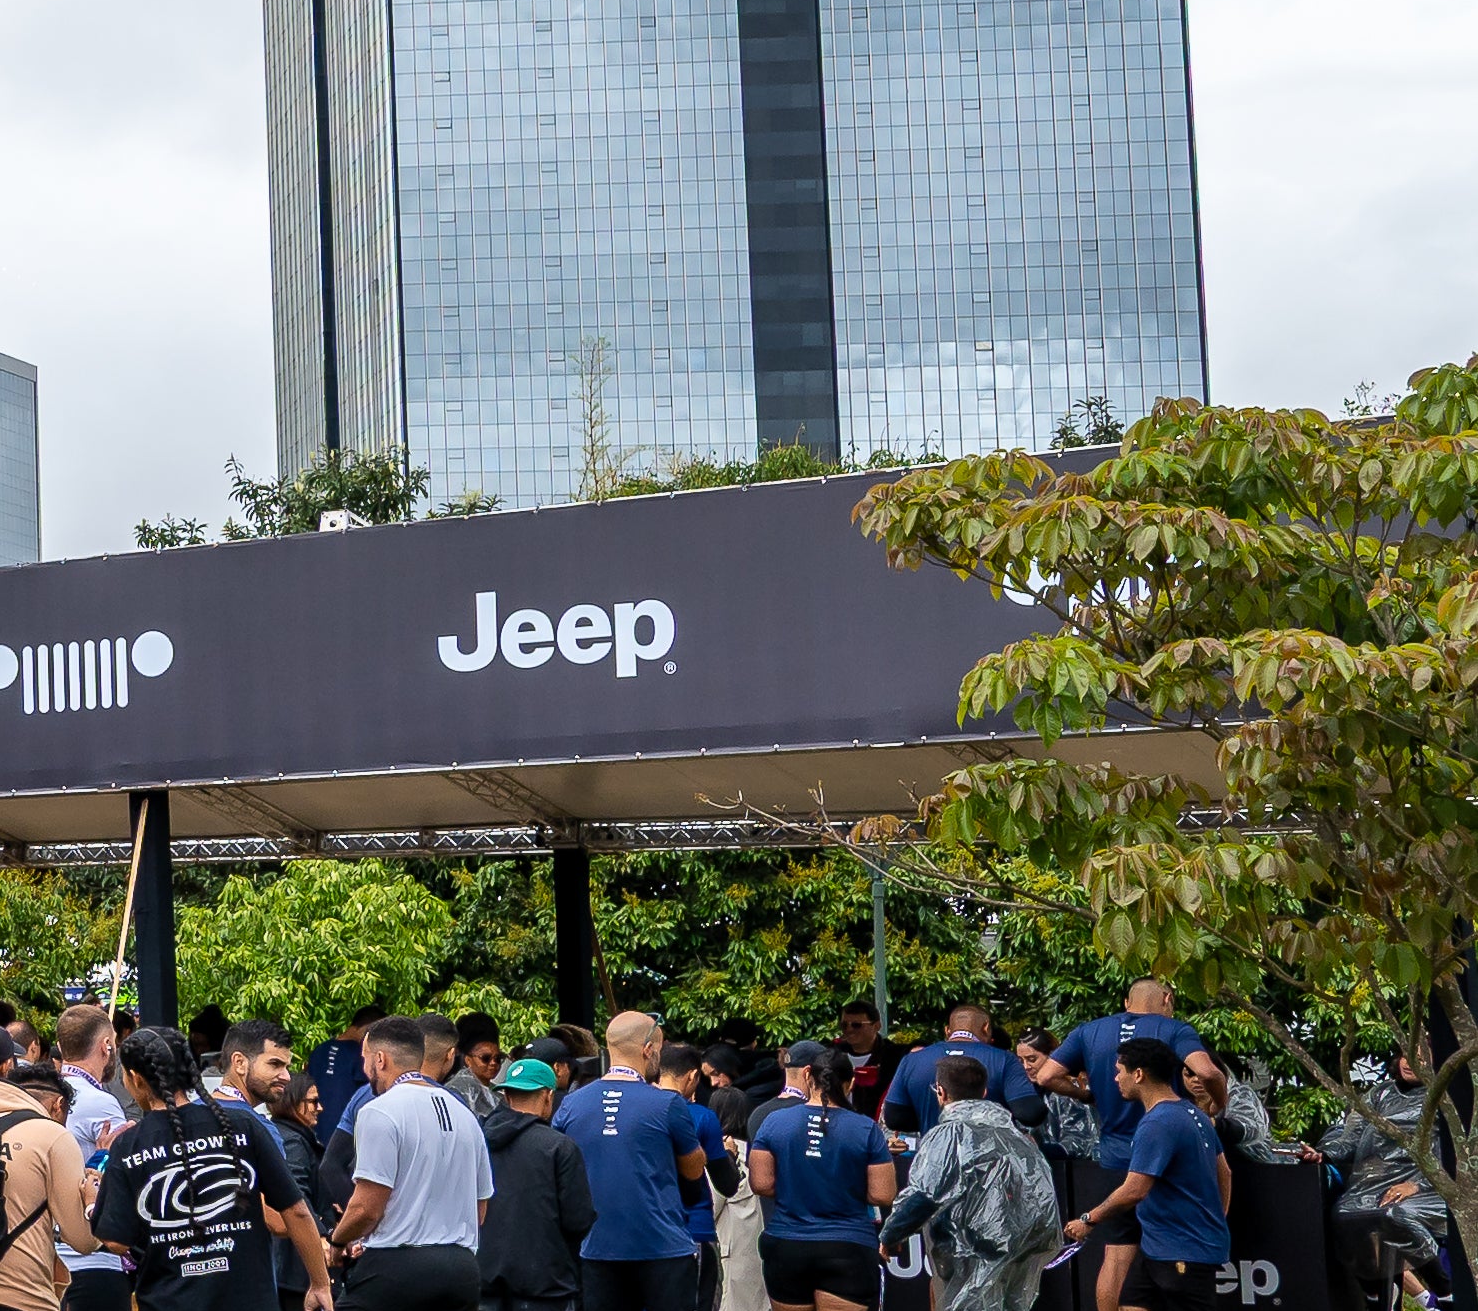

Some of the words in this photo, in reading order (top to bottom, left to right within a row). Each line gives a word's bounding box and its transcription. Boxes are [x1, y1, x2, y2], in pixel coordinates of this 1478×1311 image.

[438, 592, 674, 679] Jeep
[121, 1145, 167, 1169] TEAM
[172, 1133, 248, 1156] GROWH
[167, 1230, 195, 1242] IRON
[230, 1220, 252, 1232] LIES
[1216, 1258, 1280, 1305] ep
